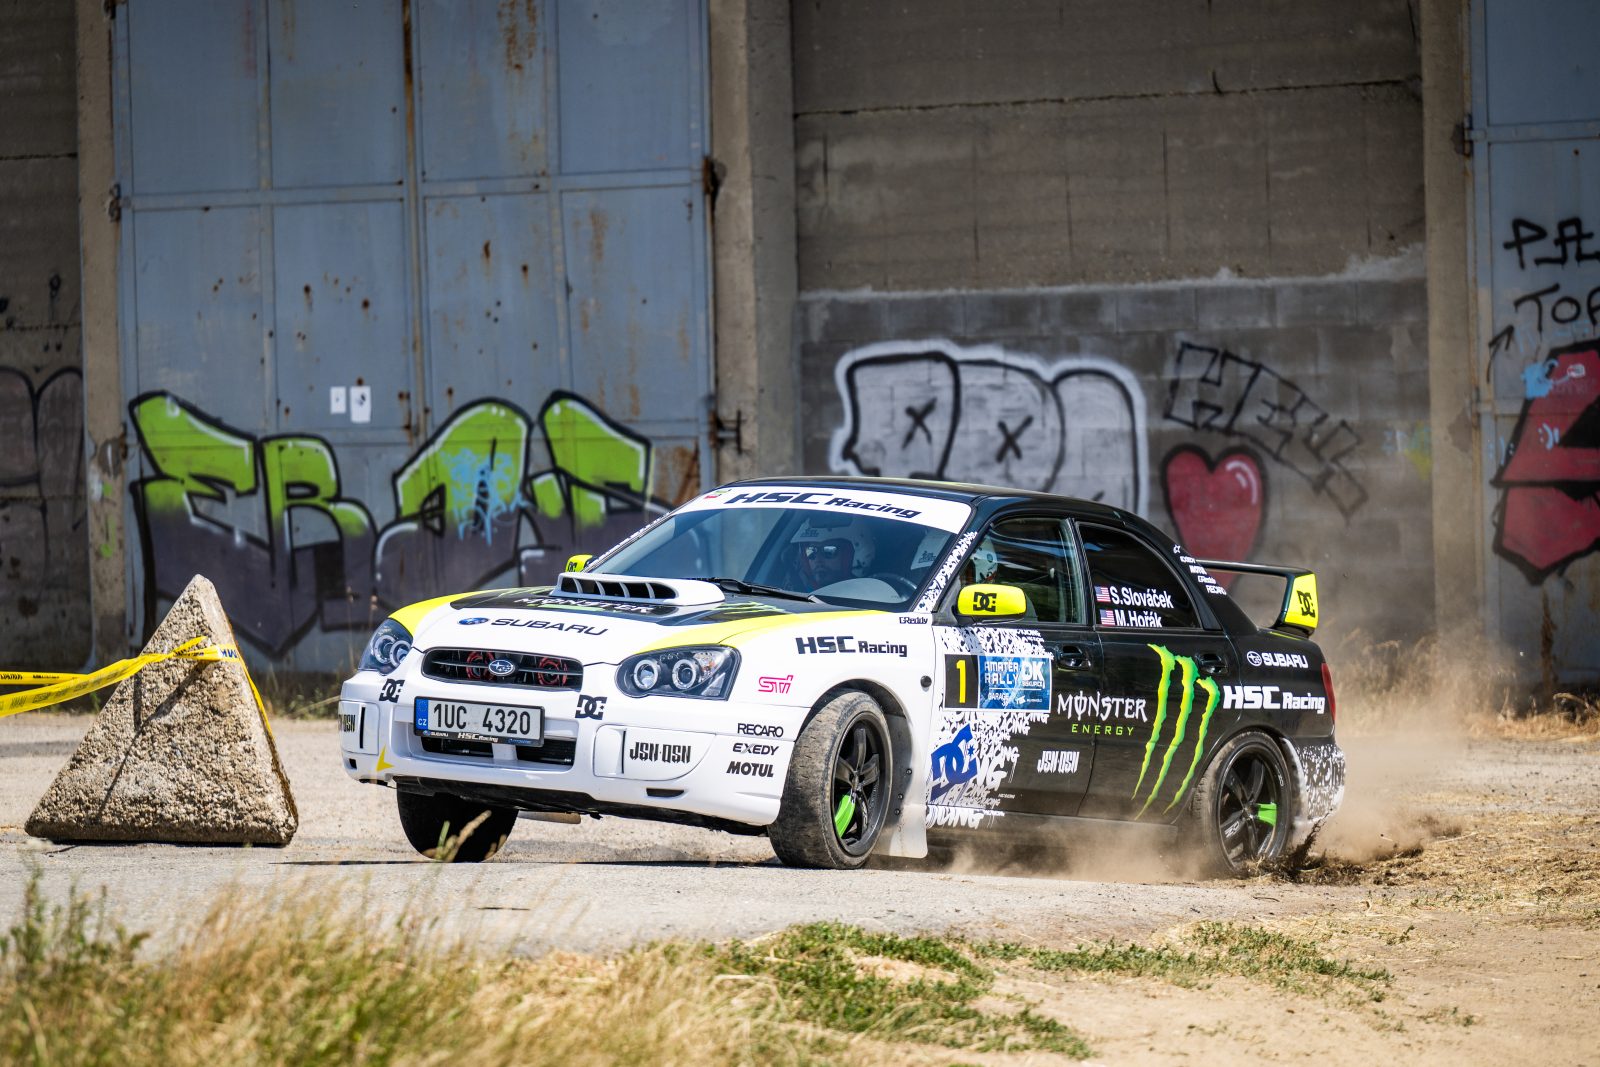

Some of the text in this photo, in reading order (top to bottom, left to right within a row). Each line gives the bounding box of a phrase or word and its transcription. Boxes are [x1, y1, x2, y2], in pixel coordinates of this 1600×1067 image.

[723, 492, 922, 519] HSC Racing
[972, 591, 997, 613] DC
[1109, 585, 1174, 609] S.Slováček
[1297, 590, 1316, 618] DC
[491, 618, 609, 636] SUBARU
[1114, 608, 1163, 628] M.Hořák
[795, 635, 908, 658] HSC Racing
[1263, 652, 1309, 669] SUBARU
[378, 678, 406, 704] DC
[956, 659, 967, 704] 1
[984, 672, 1019, 689] RALLY
[574, 694, 608, 720] DC
[1057, 690, 1148, 722] MONSTER
[1222, 685, 1325, 714] HSC Racing
[417, 718, 427, 726] CZ
[433, 703, 531, 735] 1UC 4320
[737, 722, 784, 738] RECARO
[1071, 723, 1134, 736] ENERGY
[457, 732, 480, 740] HSC
[732, 742, 780, 756] EXEDY
[726, 760, 774, 778] MOTUL
